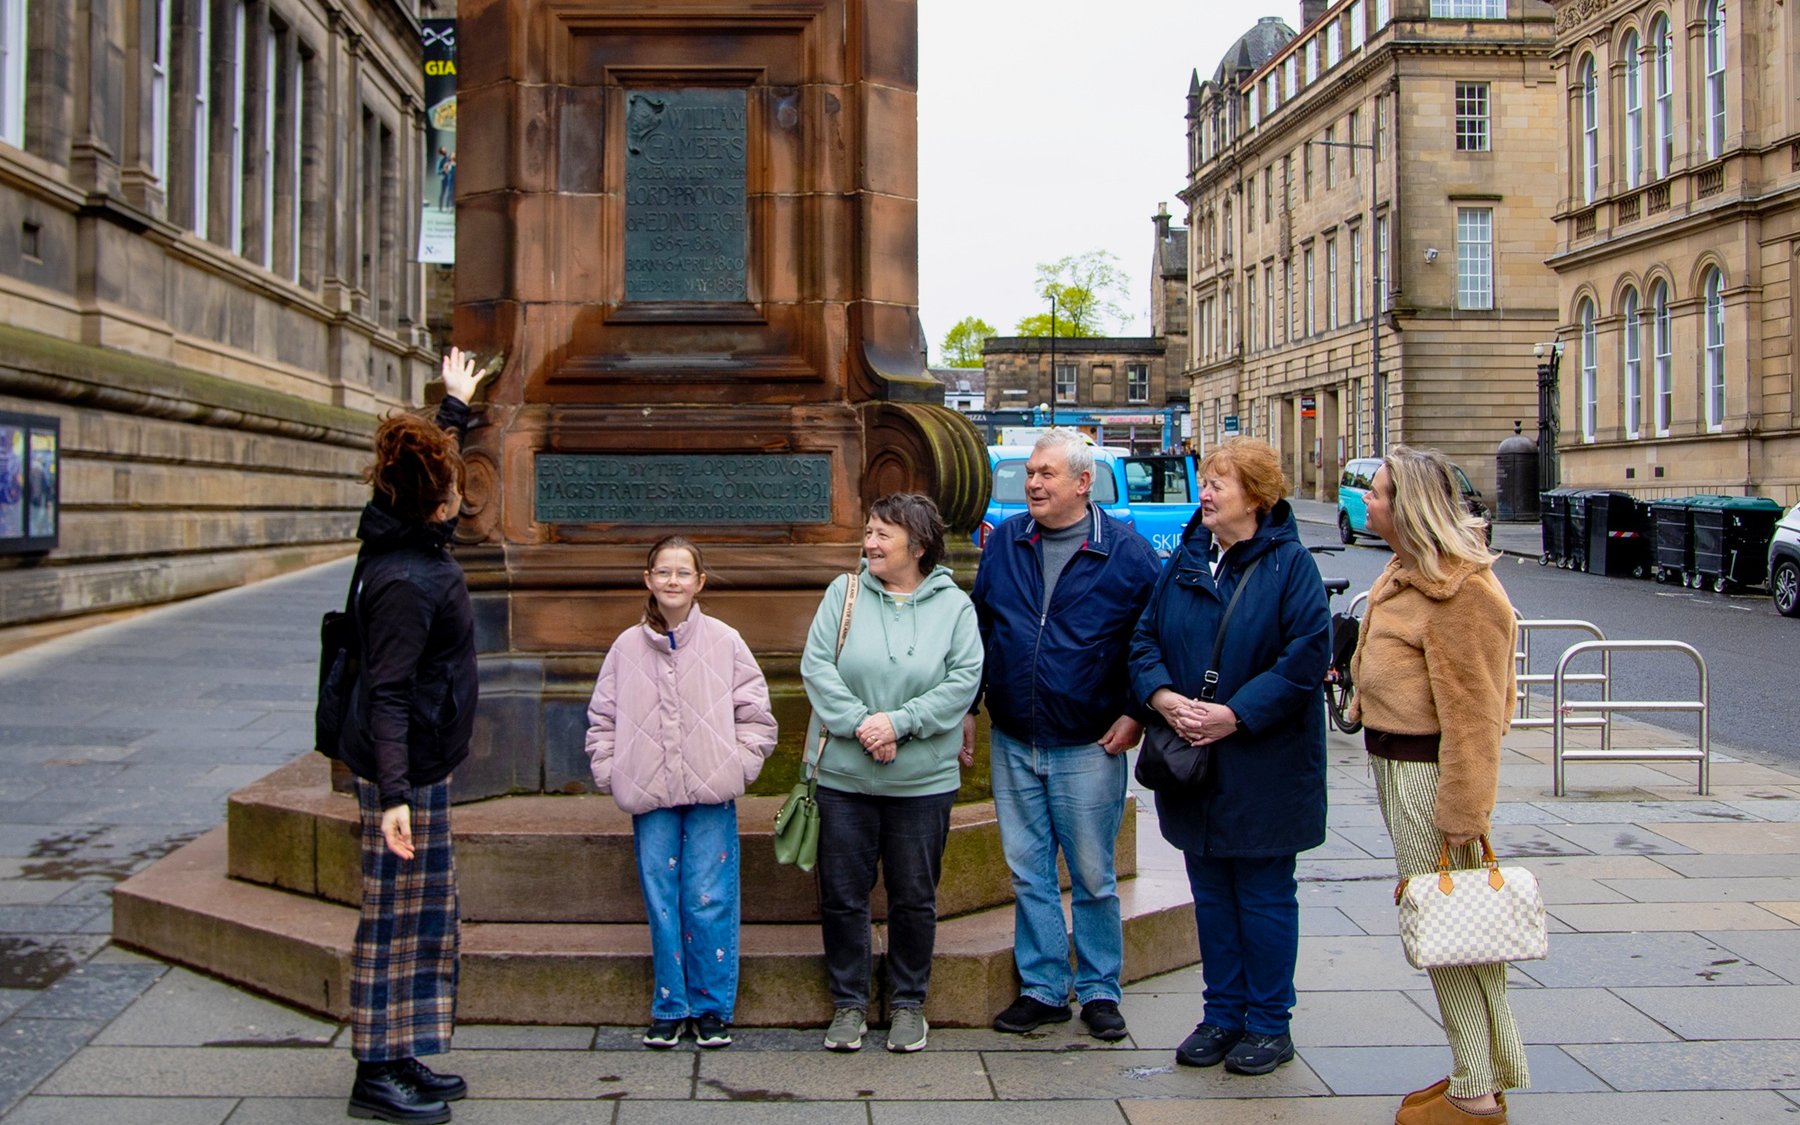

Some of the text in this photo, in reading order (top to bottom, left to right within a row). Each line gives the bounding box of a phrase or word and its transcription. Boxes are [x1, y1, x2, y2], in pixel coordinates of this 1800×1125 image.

[666, 105, 746, 131] WILLIAM
[627, 185, 746, 207] LORD PROVOST
[626, 210, 746, 234] OF EDINBURGH
[626, 257, 656, 273] BORN
[675, 256, 711, 275] APRIL
[627, 277, 657, 293] DIED
[683, 277, 710, 292] MAY
[538, 457, 828, 480] ERECTED BY THE LORD PROVOST
[538, 479, 828, 503] MAGISTRATES AND COUNCIL 1891
[538, 503, 566, 520] THE
[567, 503, 605, 520] RIGHT
[651, 503, 685, 522] JOHN
[687, 503, 725, 519] BOYD
[728, 503, 764, 520] LORD
[767, 502, 828, 521] PROVOST
